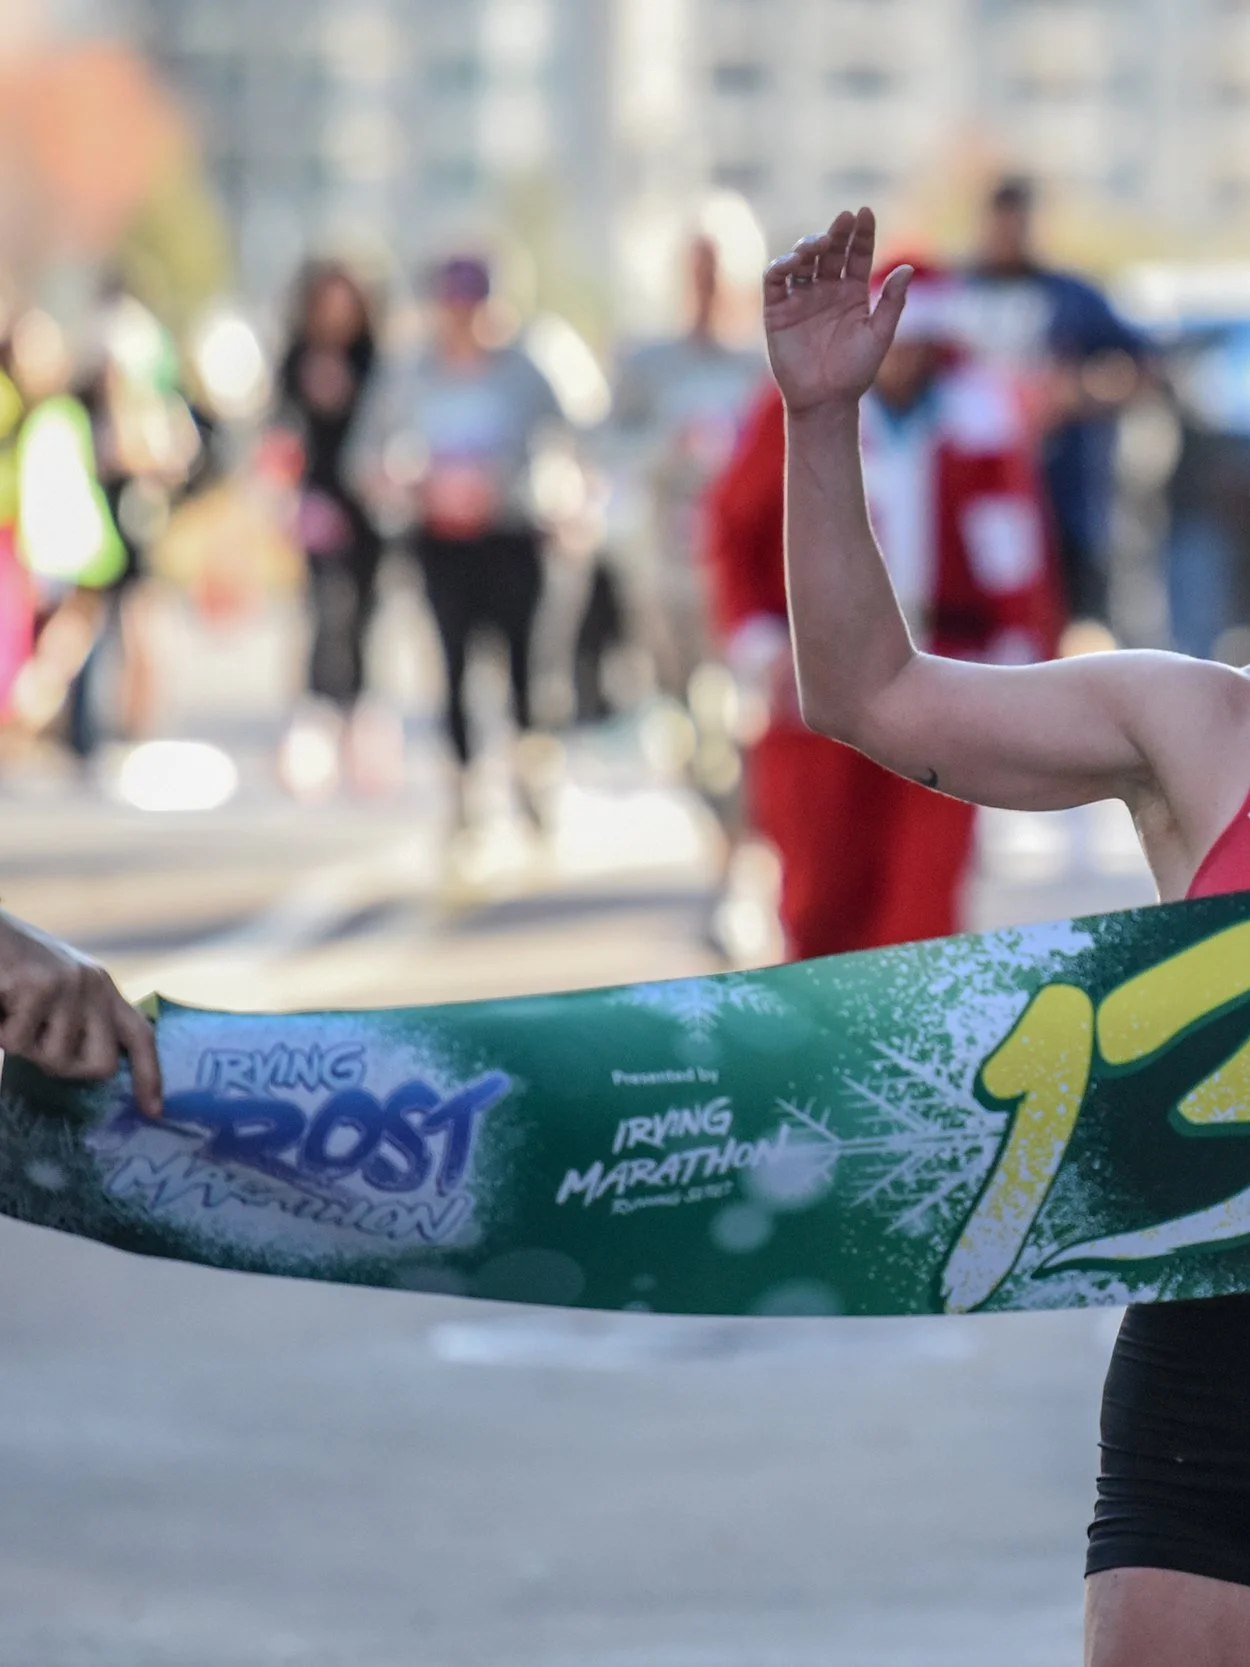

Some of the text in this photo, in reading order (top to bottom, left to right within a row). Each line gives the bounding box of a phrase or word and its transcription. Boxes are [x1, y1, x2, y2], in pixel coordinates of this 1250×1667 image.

[198, 1042, 366, 1096] IRVING
[611, 1065, 719, 1086] Presented by
[611, 1096, 734, 1155] IRVING
[556, 1121, 791, 1206] MARATHON
